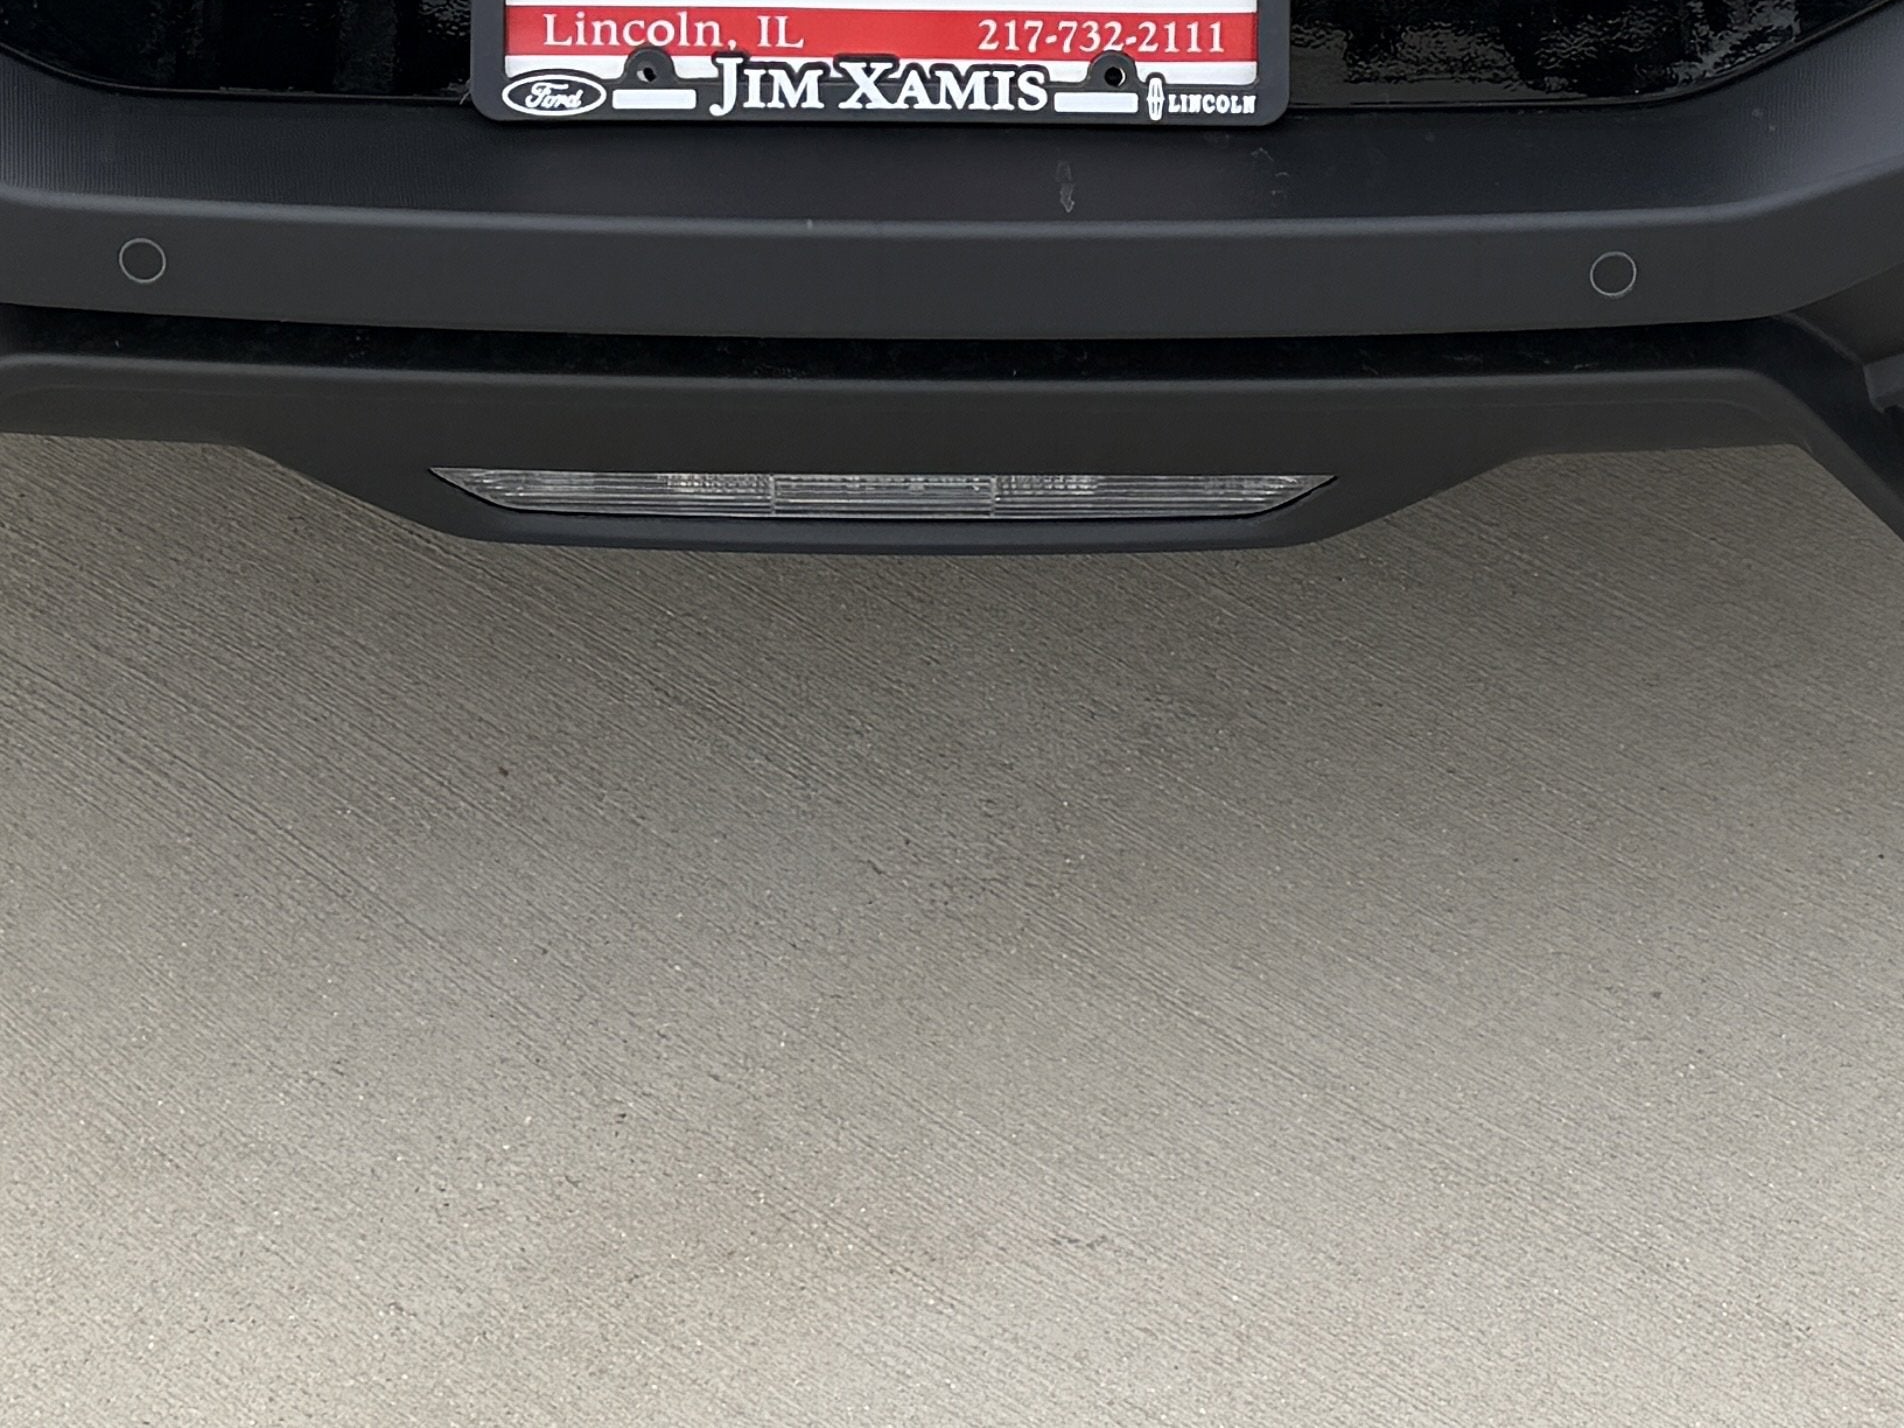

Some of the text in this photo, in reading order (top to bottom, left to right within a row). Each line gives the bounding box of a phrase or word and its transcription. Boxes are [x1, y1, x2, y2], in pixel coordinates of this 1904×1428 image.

[542, 11, 805, 49] Lincoln, IL
[976, 19, 1226, 55] 217-732-2111
[524, 81, 584, 109] Ford
[708, 57, 1049, 117] JIM XAMIS
[1167, 93, 1256, 115] LINCOLN
